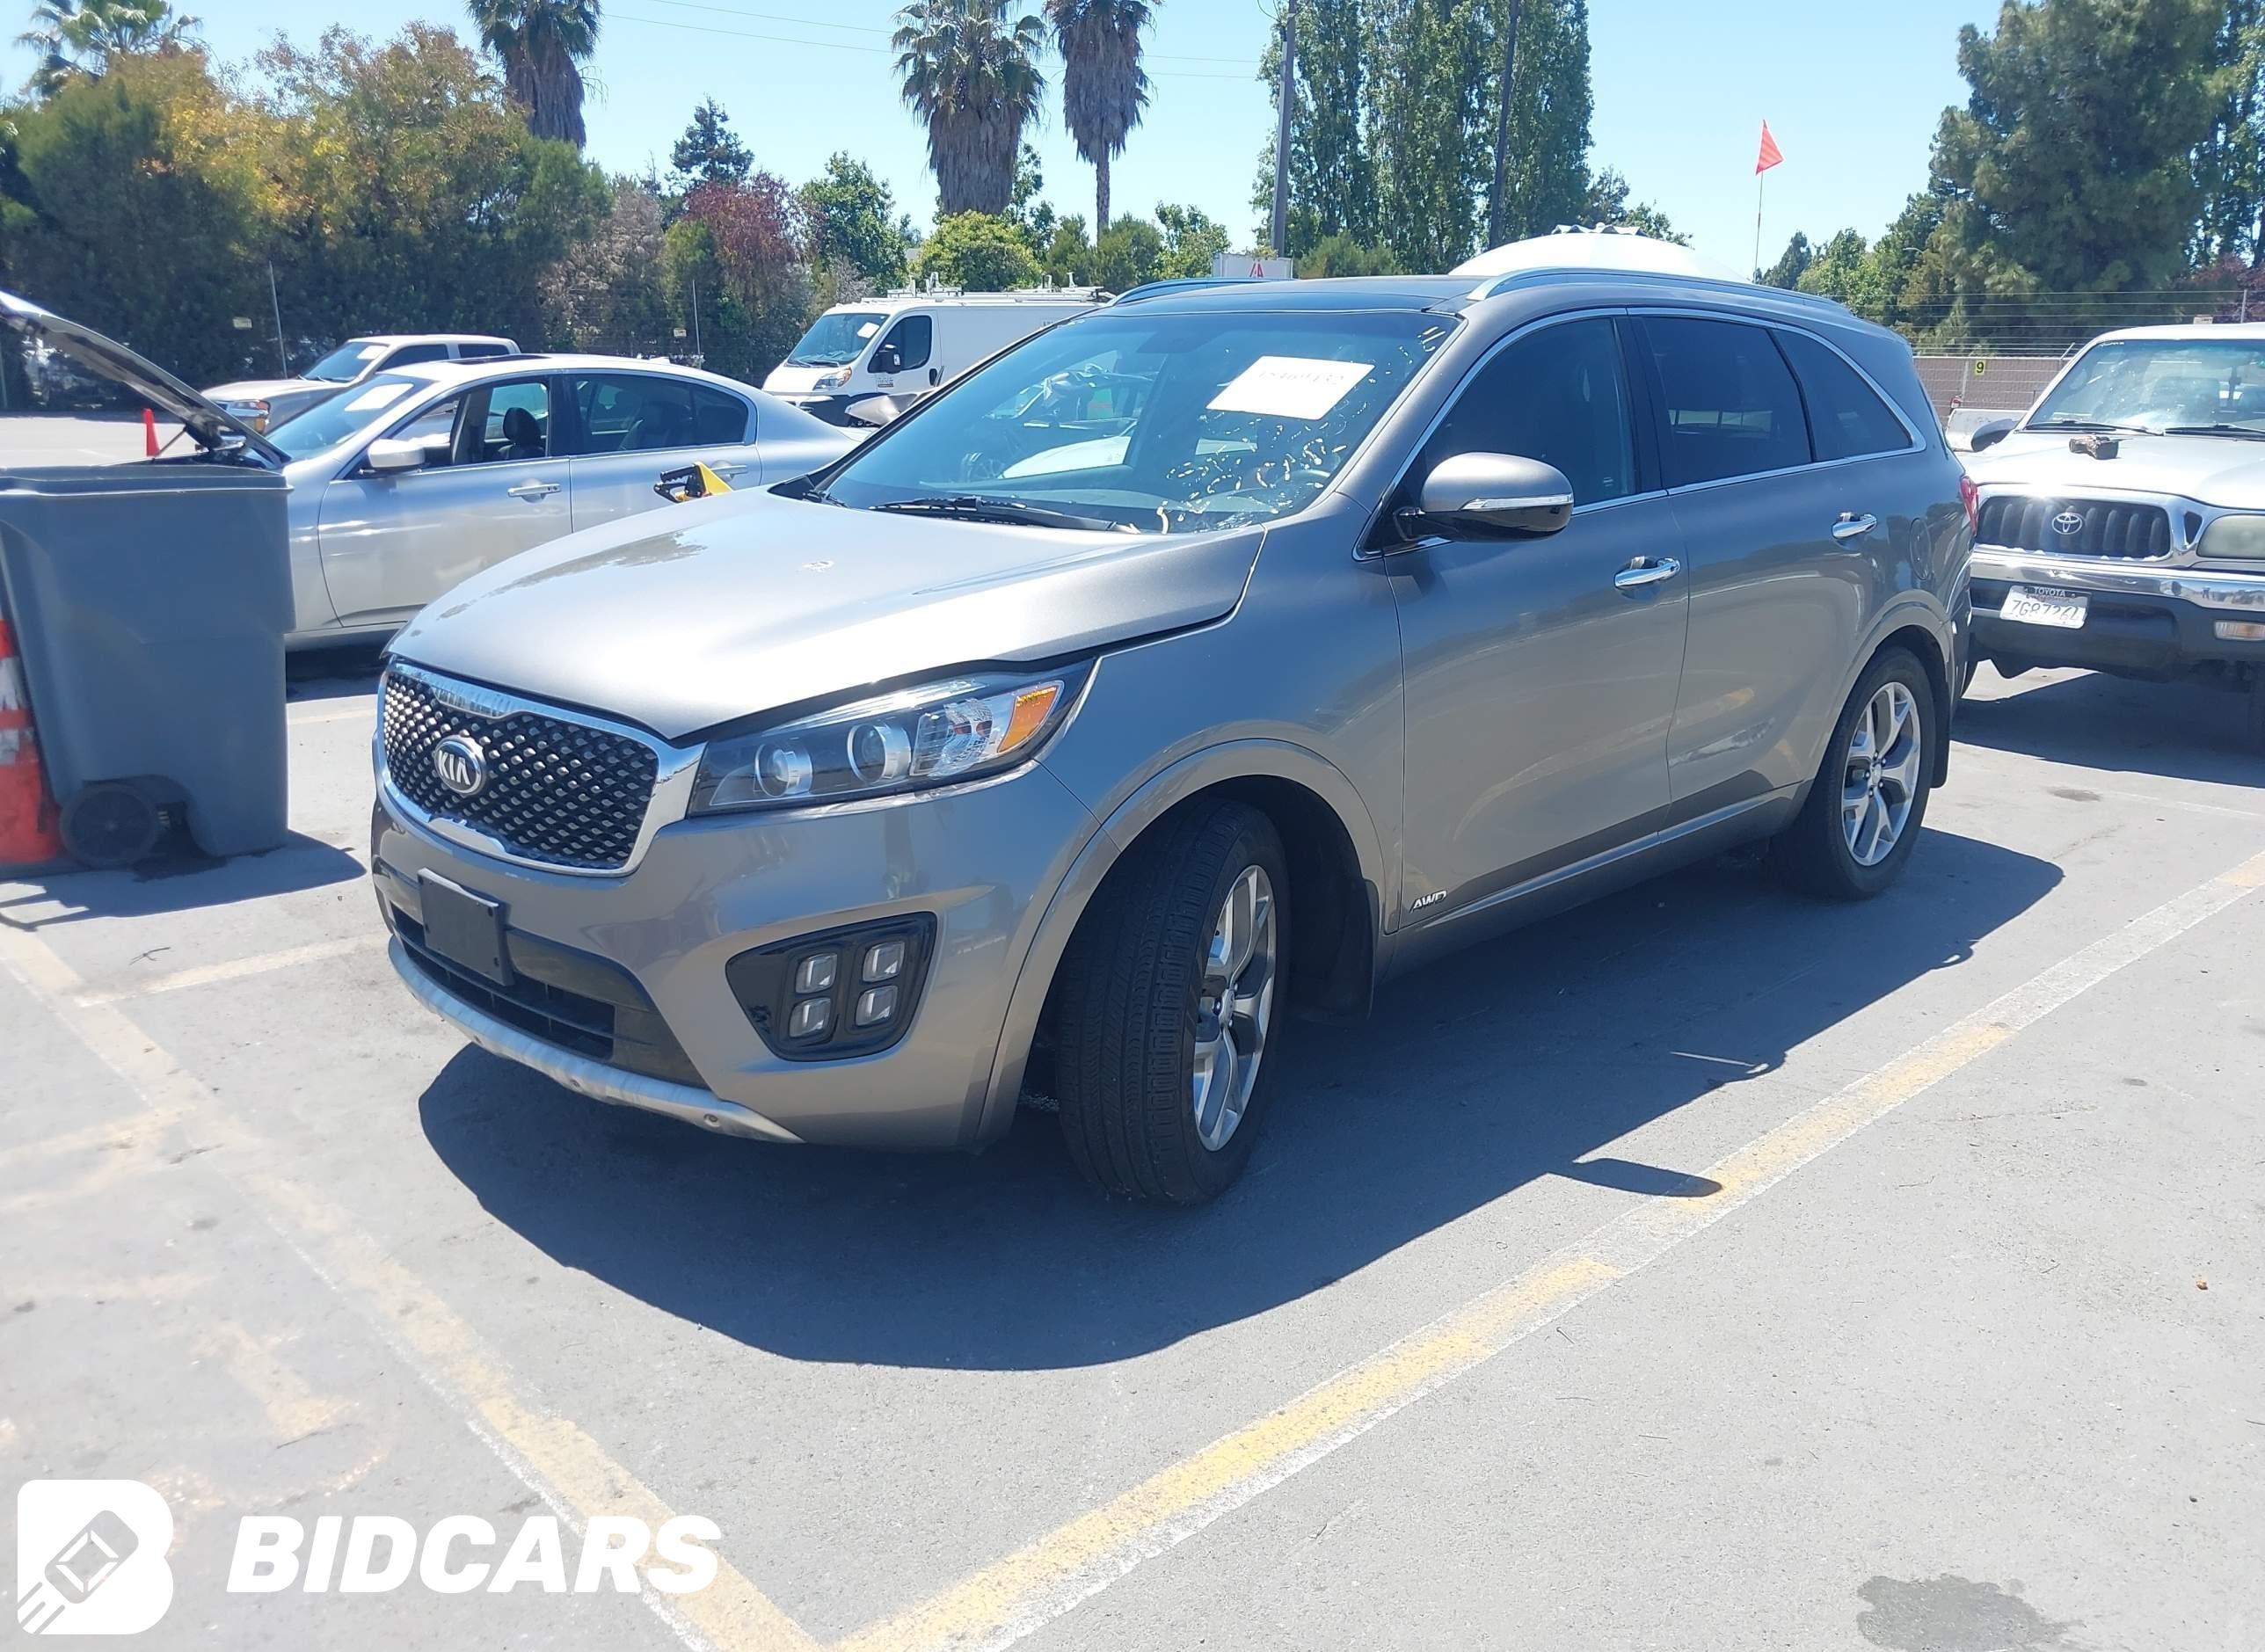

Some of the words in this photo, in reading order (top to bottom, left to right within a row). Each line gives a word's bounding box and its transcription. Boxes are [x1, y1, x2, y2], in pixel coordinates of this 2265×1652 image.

[1976, 361, 1985, 374] 9
[2034, 586, 2066, 598] TOYOTA
[438, 749, 471, 786] KIA
[1409, 890, 1447, 913] AWD
